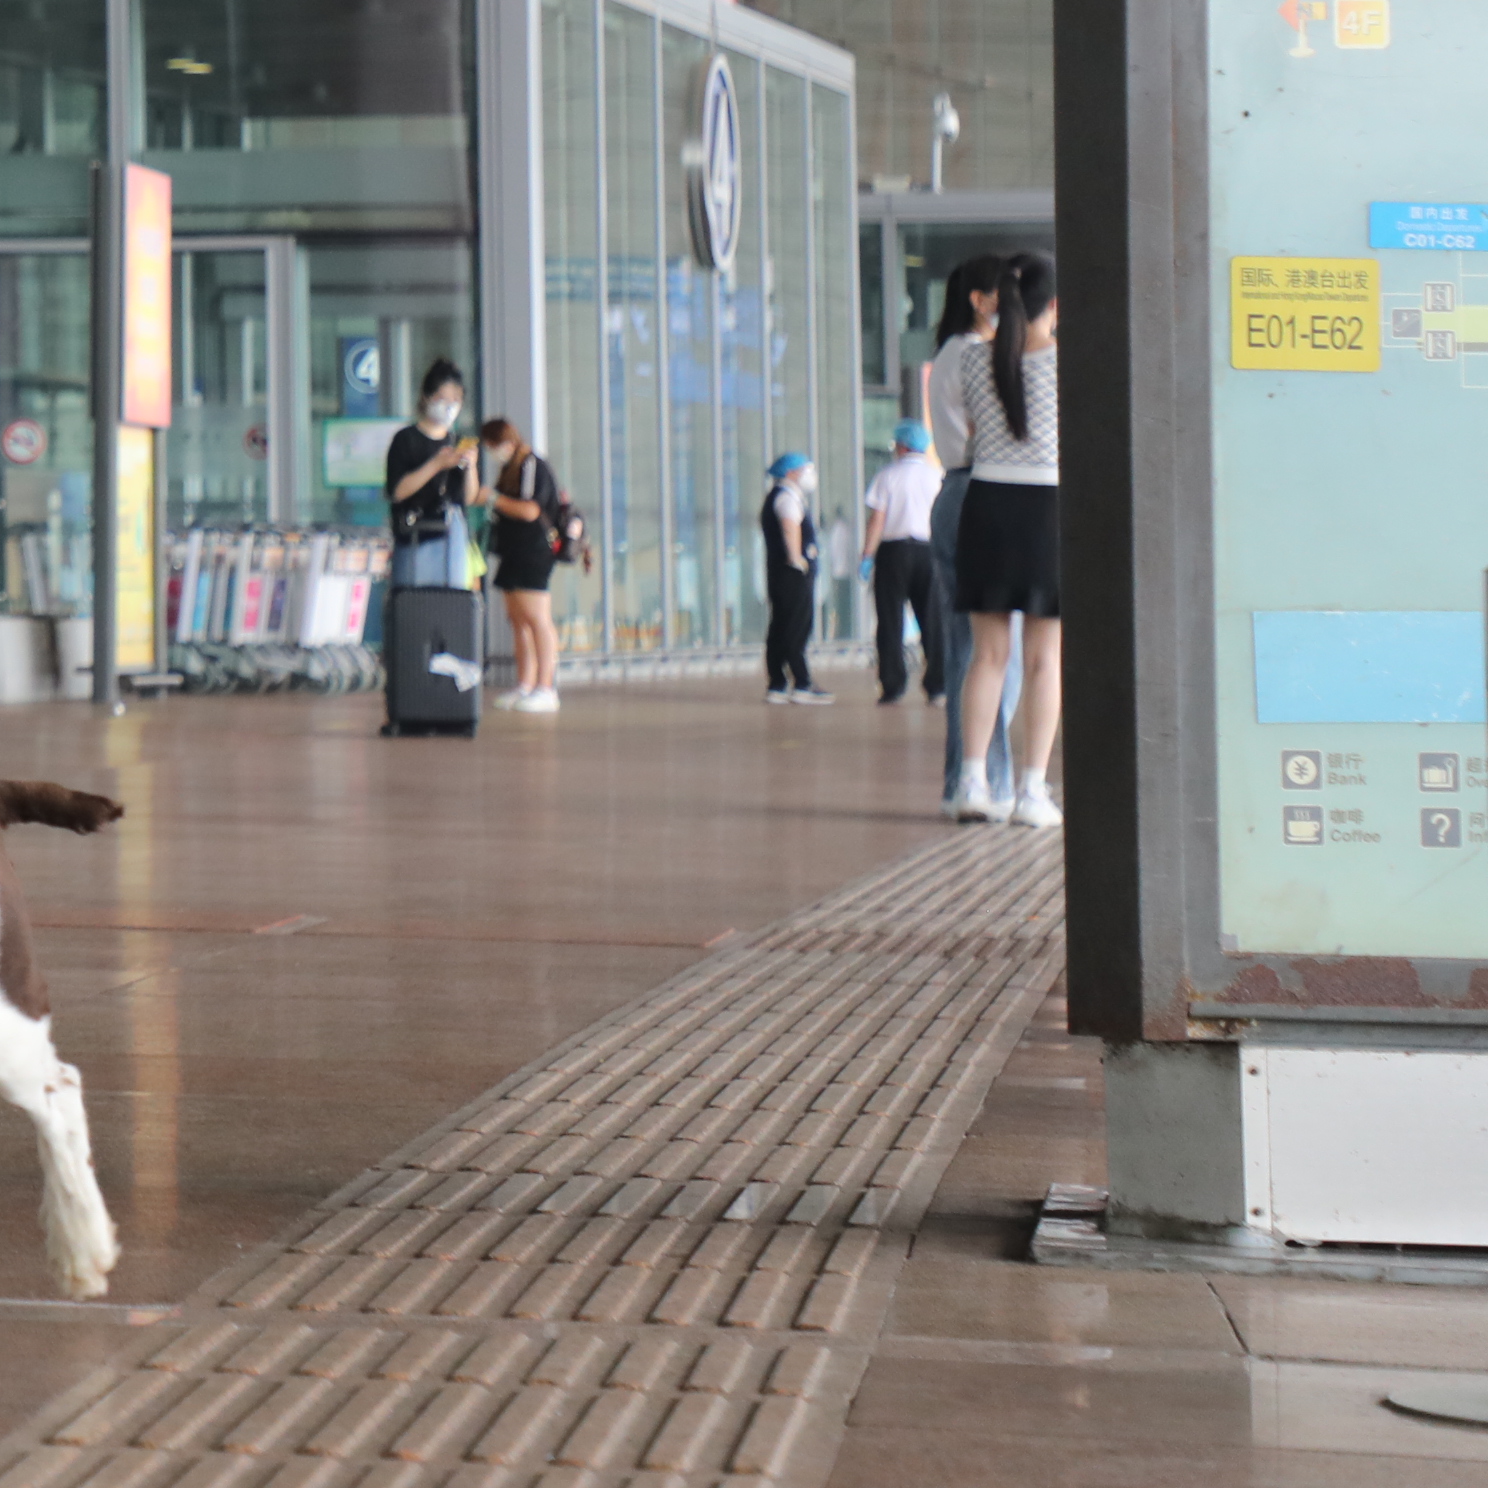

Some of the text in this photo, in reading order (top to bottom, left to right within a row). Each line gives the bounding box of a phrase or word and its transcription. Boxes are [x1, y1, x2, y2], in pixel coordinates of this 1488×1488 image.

[1343, 11, 1381, 35] 4F
[1404, 233, 1475, 249] C01-C62
[1241, 267, 1370, 290] 国际、港澳台出发
[1248, 313, 1364, 350] E01-E62
[1327, 753, 1364, 770] 银行
[1328, 772, 1367, 786] Bank
[1331, 828, 1382, 844] Coffee
